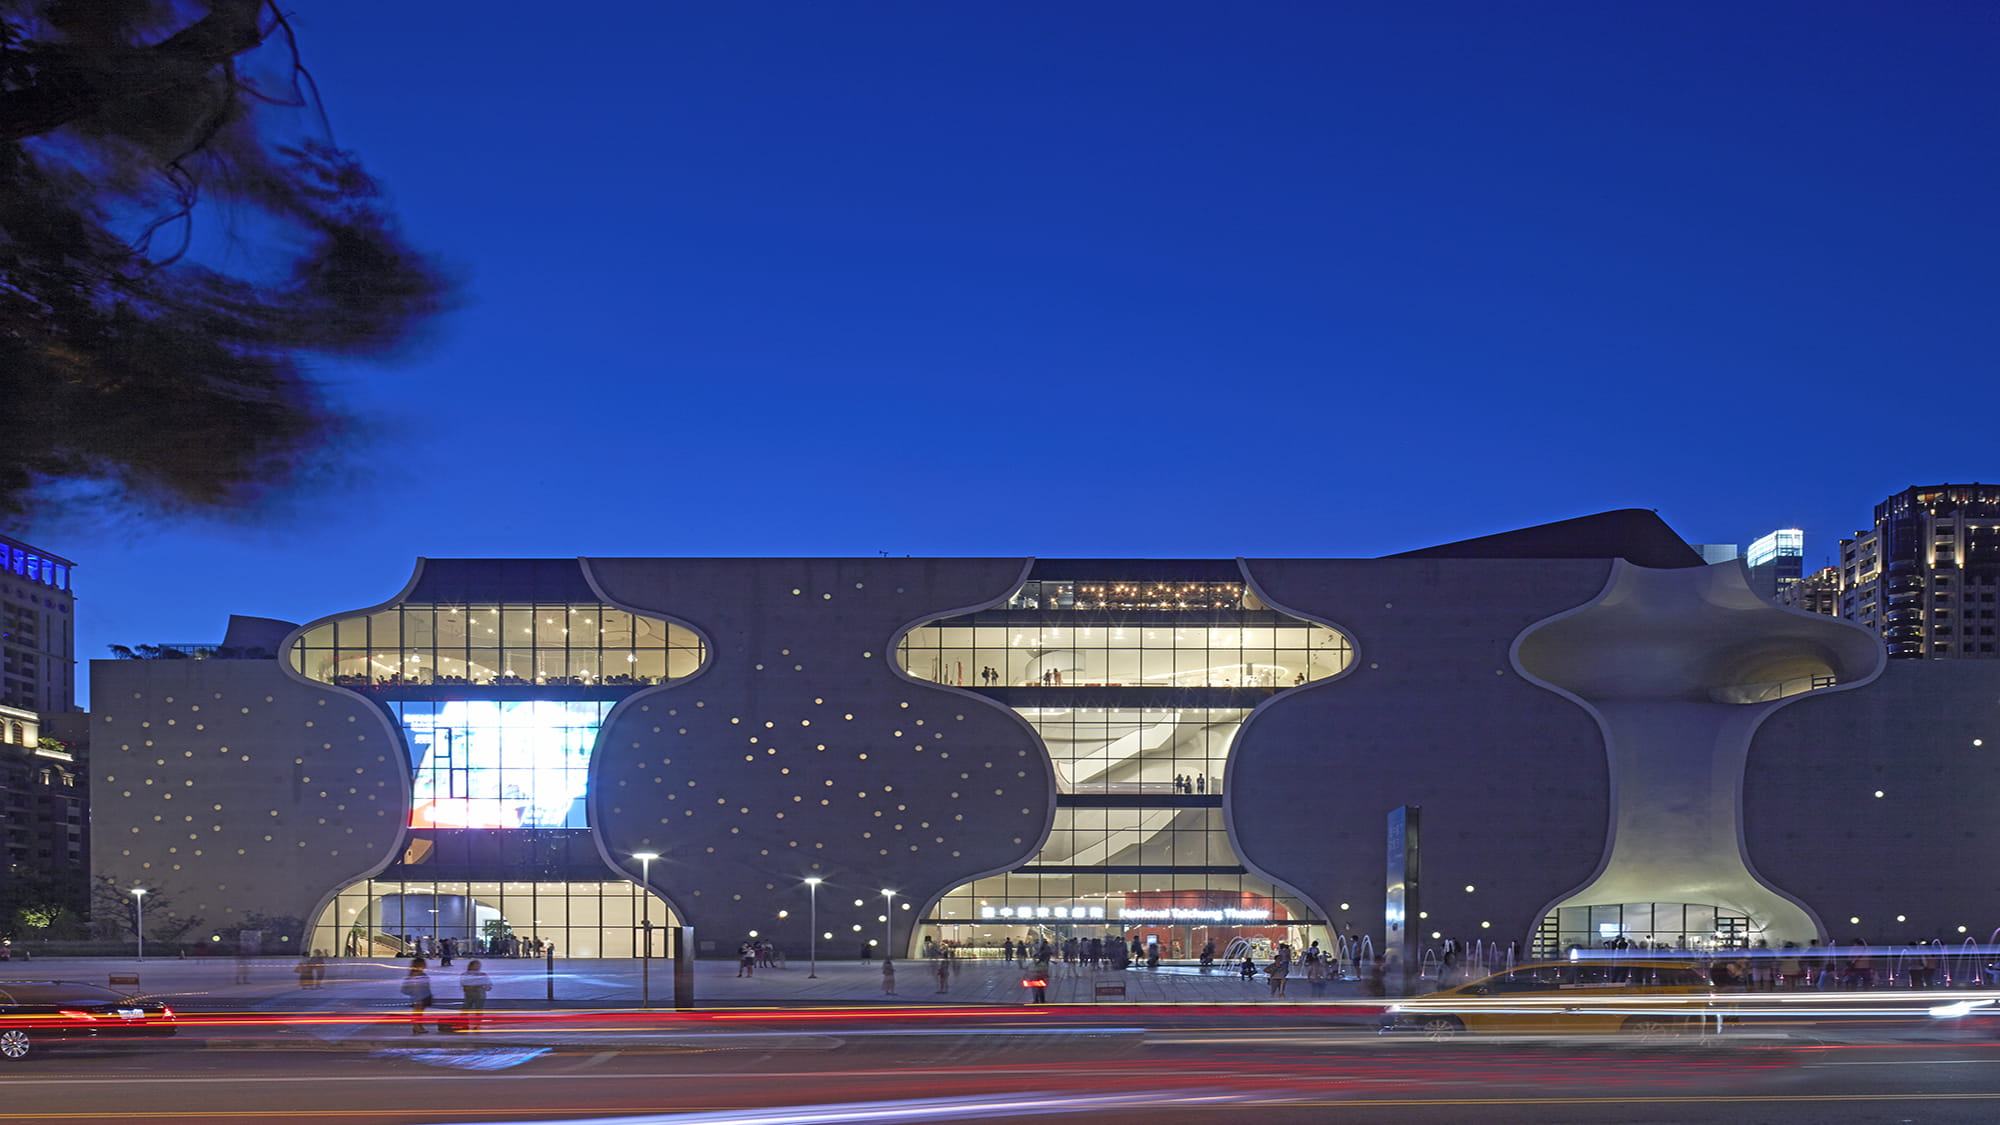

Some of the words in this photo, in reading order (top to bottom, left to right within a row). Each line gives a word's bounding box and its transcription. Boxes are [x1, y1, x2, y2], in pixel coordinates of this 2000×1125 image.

[981, 906, 1104, 919] 中國家院
[1118, 908, 1170, 919] National
